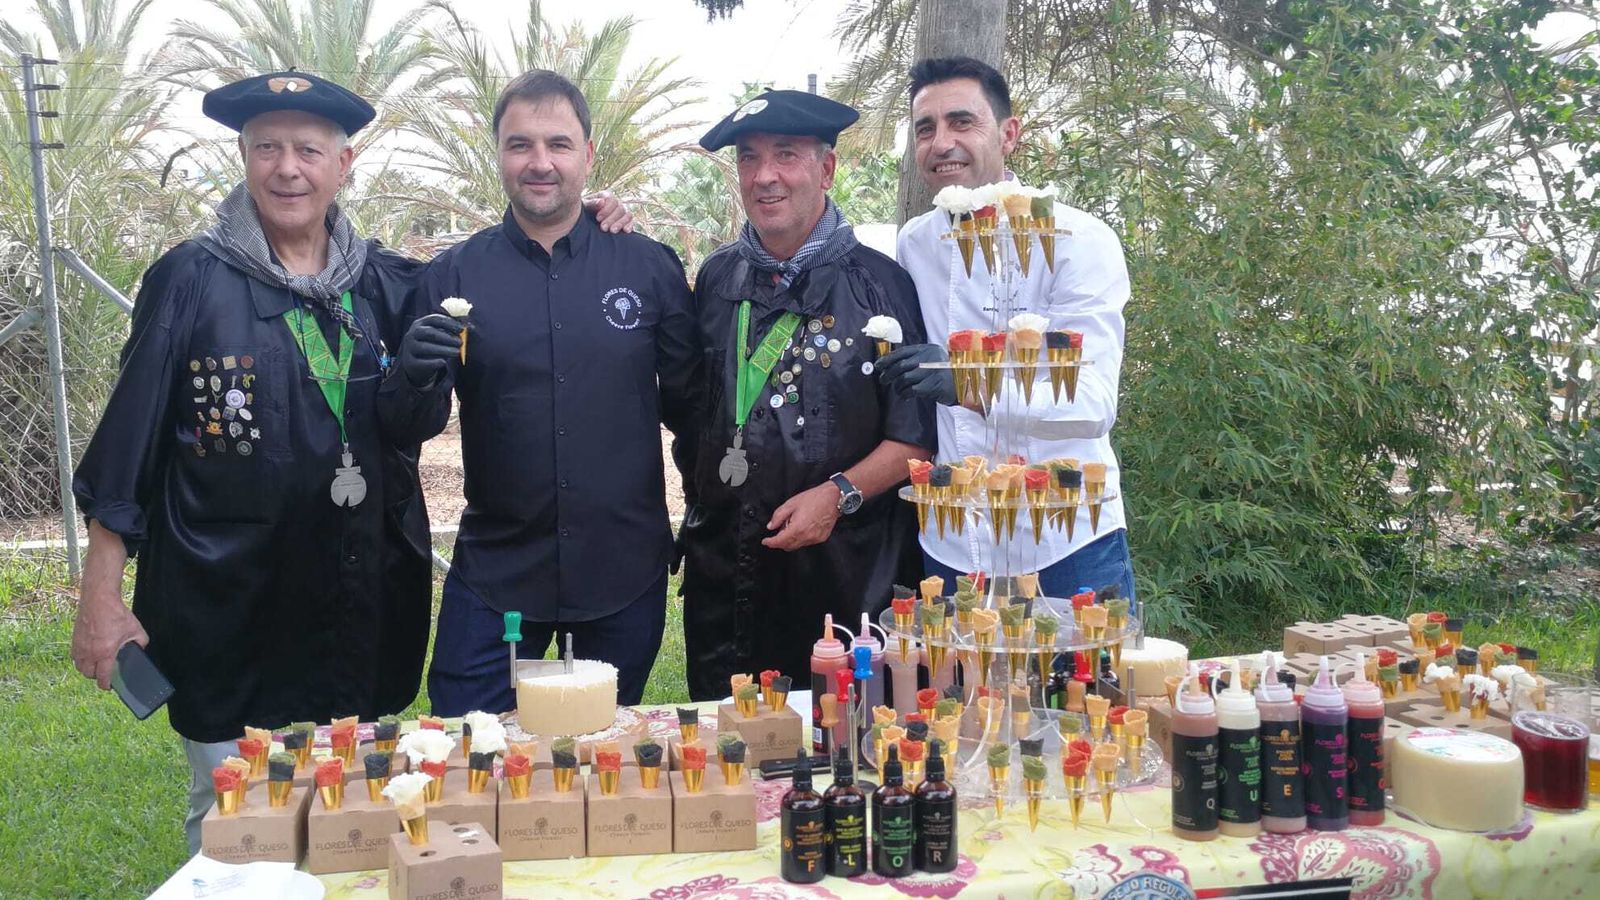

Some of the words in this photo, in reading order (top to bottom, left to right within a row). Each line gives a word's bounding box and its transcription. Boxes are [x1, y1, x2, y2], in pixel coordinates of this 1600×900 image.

[602, 289, 618, 304] FLORES
[628, 290, 641, 307] QUESO
[1250, 790, 1258, 801] U
[1283, 784, 1291, 796] E
[1336, 786, 1343, 798] S
[1206, 798, 1215, 809] Q
[259, 843, 288, 852] QUESO
[365, 838, 389, 847] QUES
[849, 854, 855, 865] L
[892, 855, 903, 867] O
[933, 851, 942, 862] R
[808, 860, 815, 872] F
[468, 883, 499, 895] QUESO
[1107, 879, 1139, 900] SEJO
